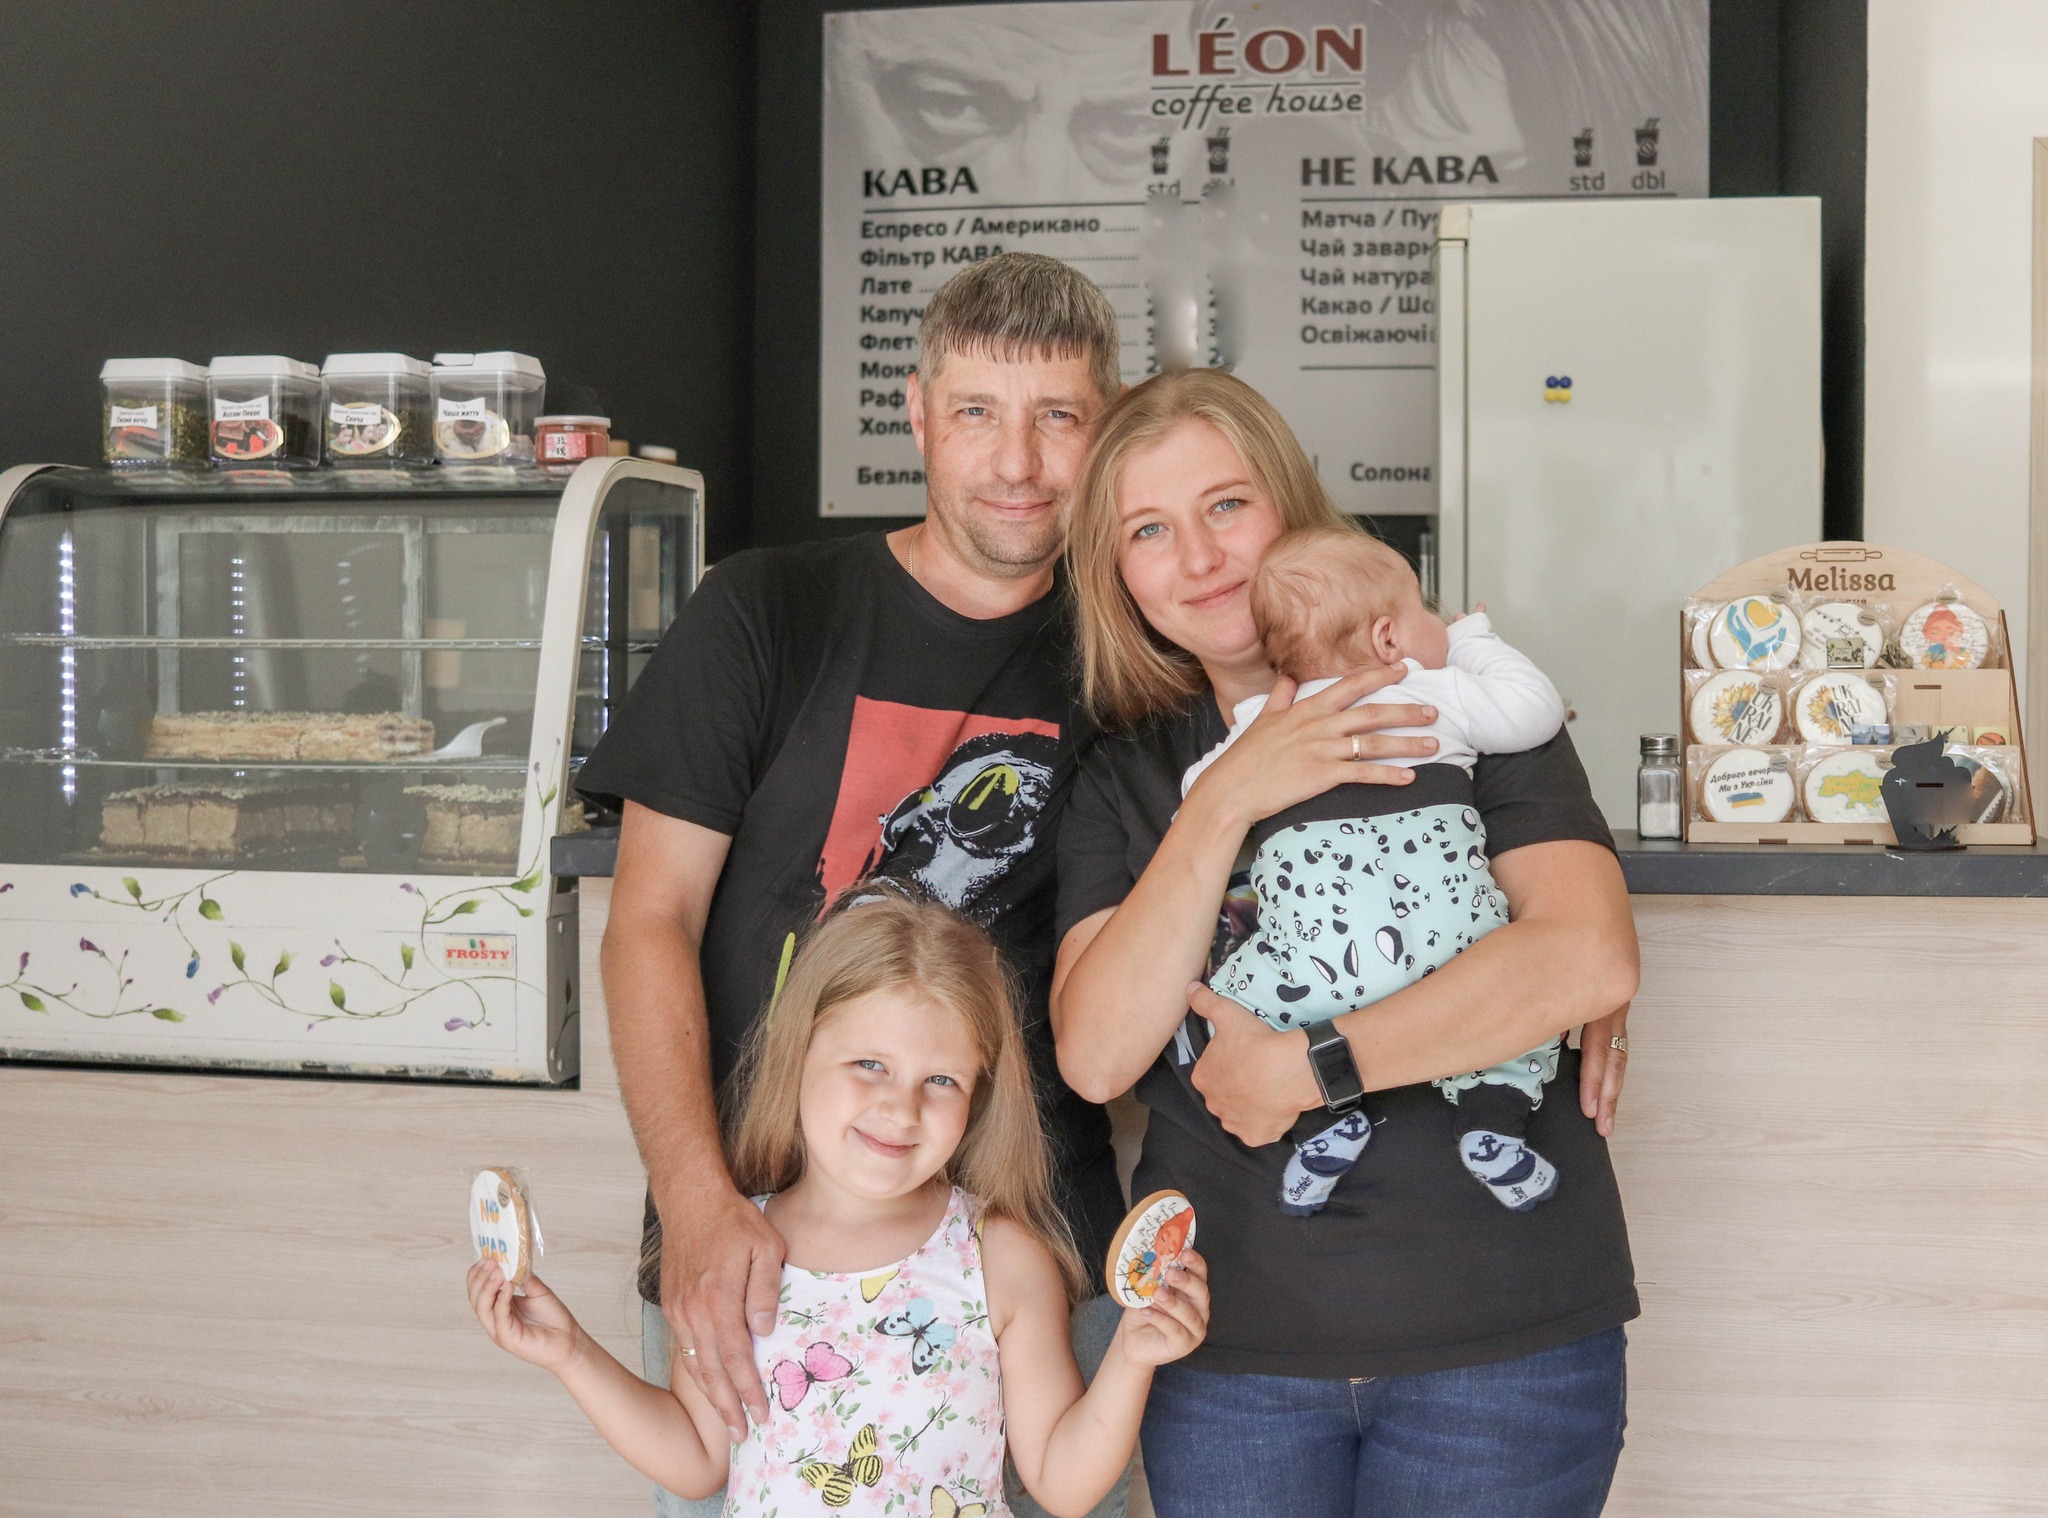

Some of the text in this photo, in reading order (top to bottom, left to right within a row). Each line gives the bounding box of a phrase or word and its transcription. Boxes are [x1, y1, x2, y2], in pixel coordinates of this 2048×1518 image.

[1153, 17, 1362, 76] LÉON
[1151, 83, 1363, 130] coffee house
[1301, 154, 1499, 186] НЕ КАВА
[863, 166, 979, 198] КАВА
[1570, 171, 1666, 191] std dbl
[1302, 209, 1377, 228] Матча
[1383, 209, 1395, 228] /
[861, 217, 1101, 241] Еспресо / Американо
[1301, 238, 1346, 257] Чай
[860, 248, 935, 269] Фільтр
[1301, 267, 1346, 285] Чай
[861, 278, 912, 295] Лате
[1302, 297, 1373, 315] Какао
[1379, 296, 1391, 315] /
[861, 388, 906, 411] Раф
[858, 466, 928, 485] Безла
[1787, 566, 1897, 592] Melissa
[446, 949, 510, 960] FROSTY
